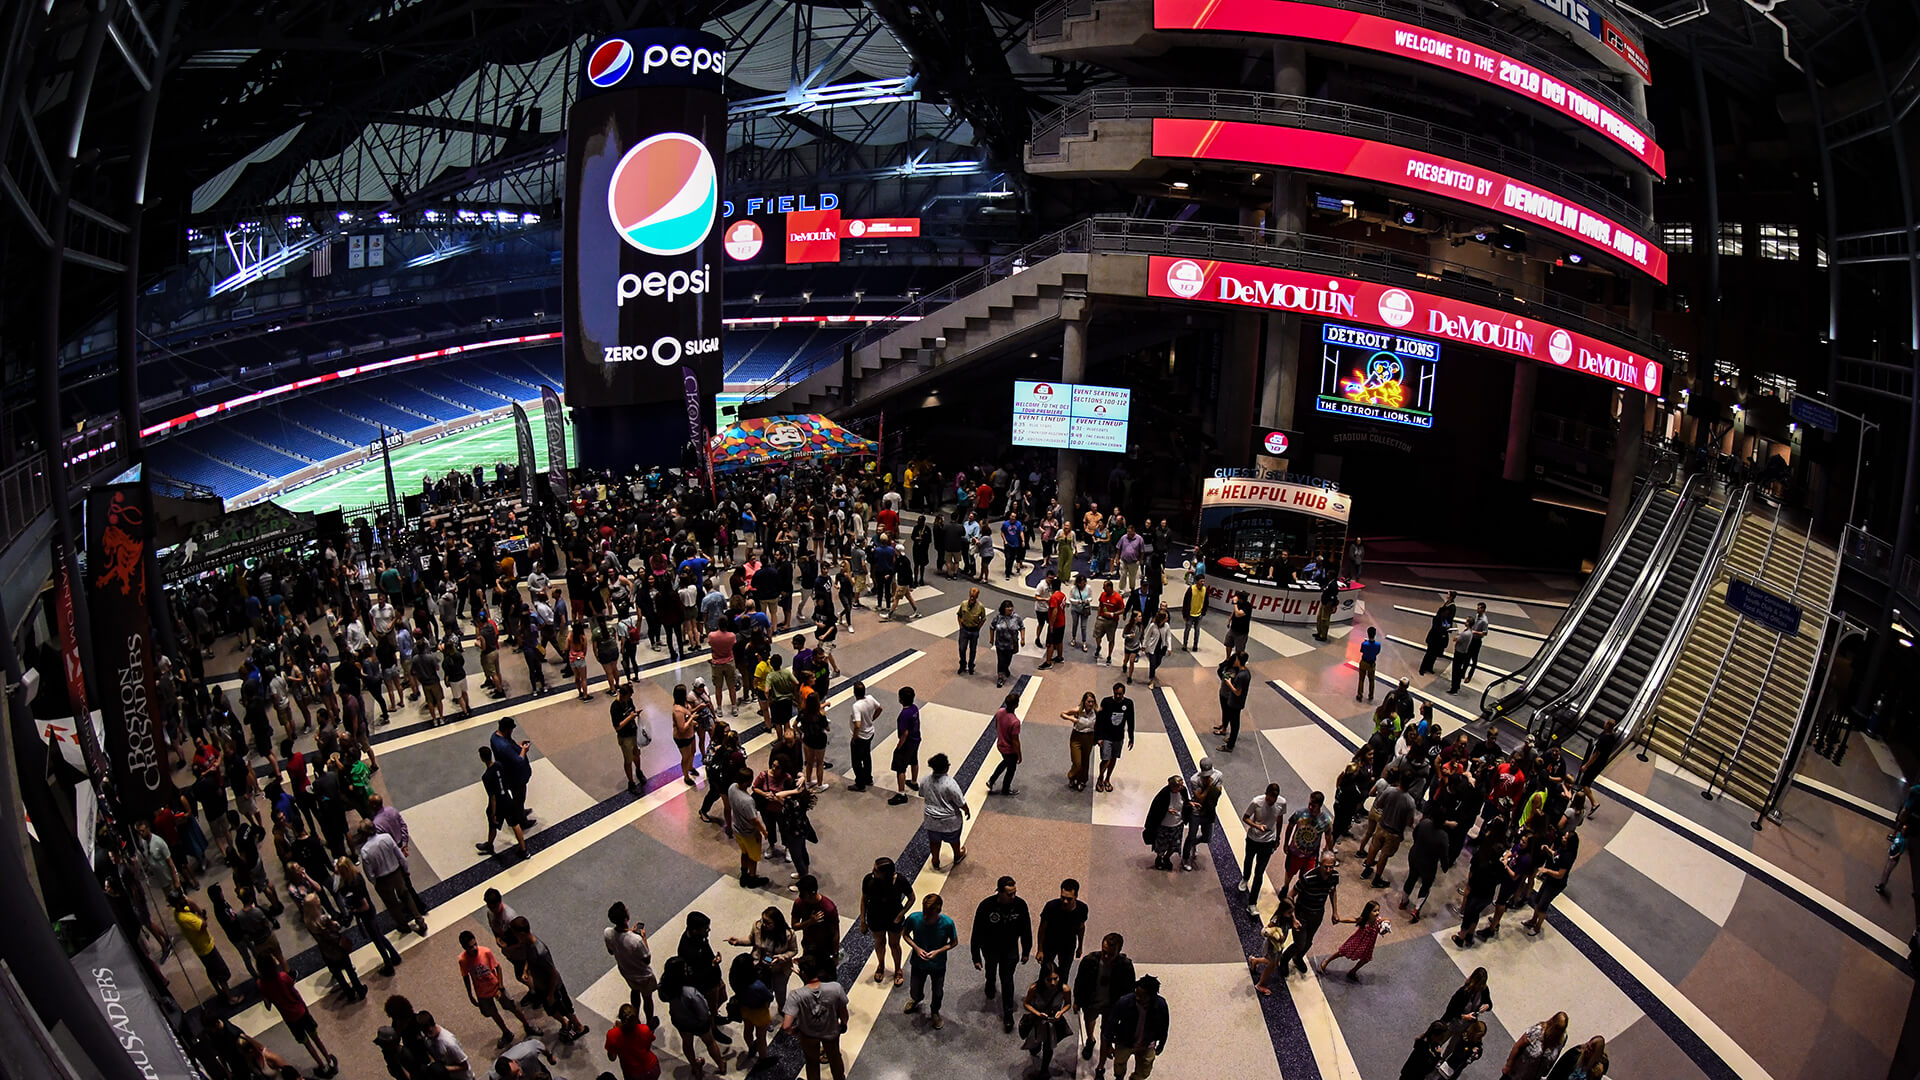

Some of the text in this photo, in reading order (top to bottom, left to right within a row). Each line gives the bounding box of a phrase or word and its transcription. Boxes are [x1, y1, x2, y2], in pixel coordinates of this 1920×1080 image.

[642, 44, 726, 75] pepsi
[1395, 30, 1645, 155] WELCOME TO THE 2018 DCI TOUR PREMIERE
[748, 193, 838, 216] FIELD
[1407, 160, 1647, 266] PRESENTED BY DEMOULIN BROS. AND CO.
[617, 264, 710, 306] pepsi
[604, 337, 719, 362] ZERO SUGAR
[1328, 328, 1435, 358] DETROIT LIONS
[1320, 401, 1428, 425] THE DETROIT LIONS, INC.
[1333, 433, 1412, 452] STADIUM COLLECTION
[750, 454, 770, 464] Drum
[1214, 468, 1340, 492] GUEST SERVICES
[1222, 484, 1288, 503] HELPFUL
[1293, 490, 1328, 510] HUB
[204, 530, 220, 541] THE
[166, 570, 179, 580] THE
[278, 534, 304, 546] CORPS
[1226, 589, 1302, 616] HLPFUL
[118, 669, 146, 773] BOSTON
[128, 634, 160, 790] CRUSADERS
[92, 968, 159, 1080] RUSADERS
